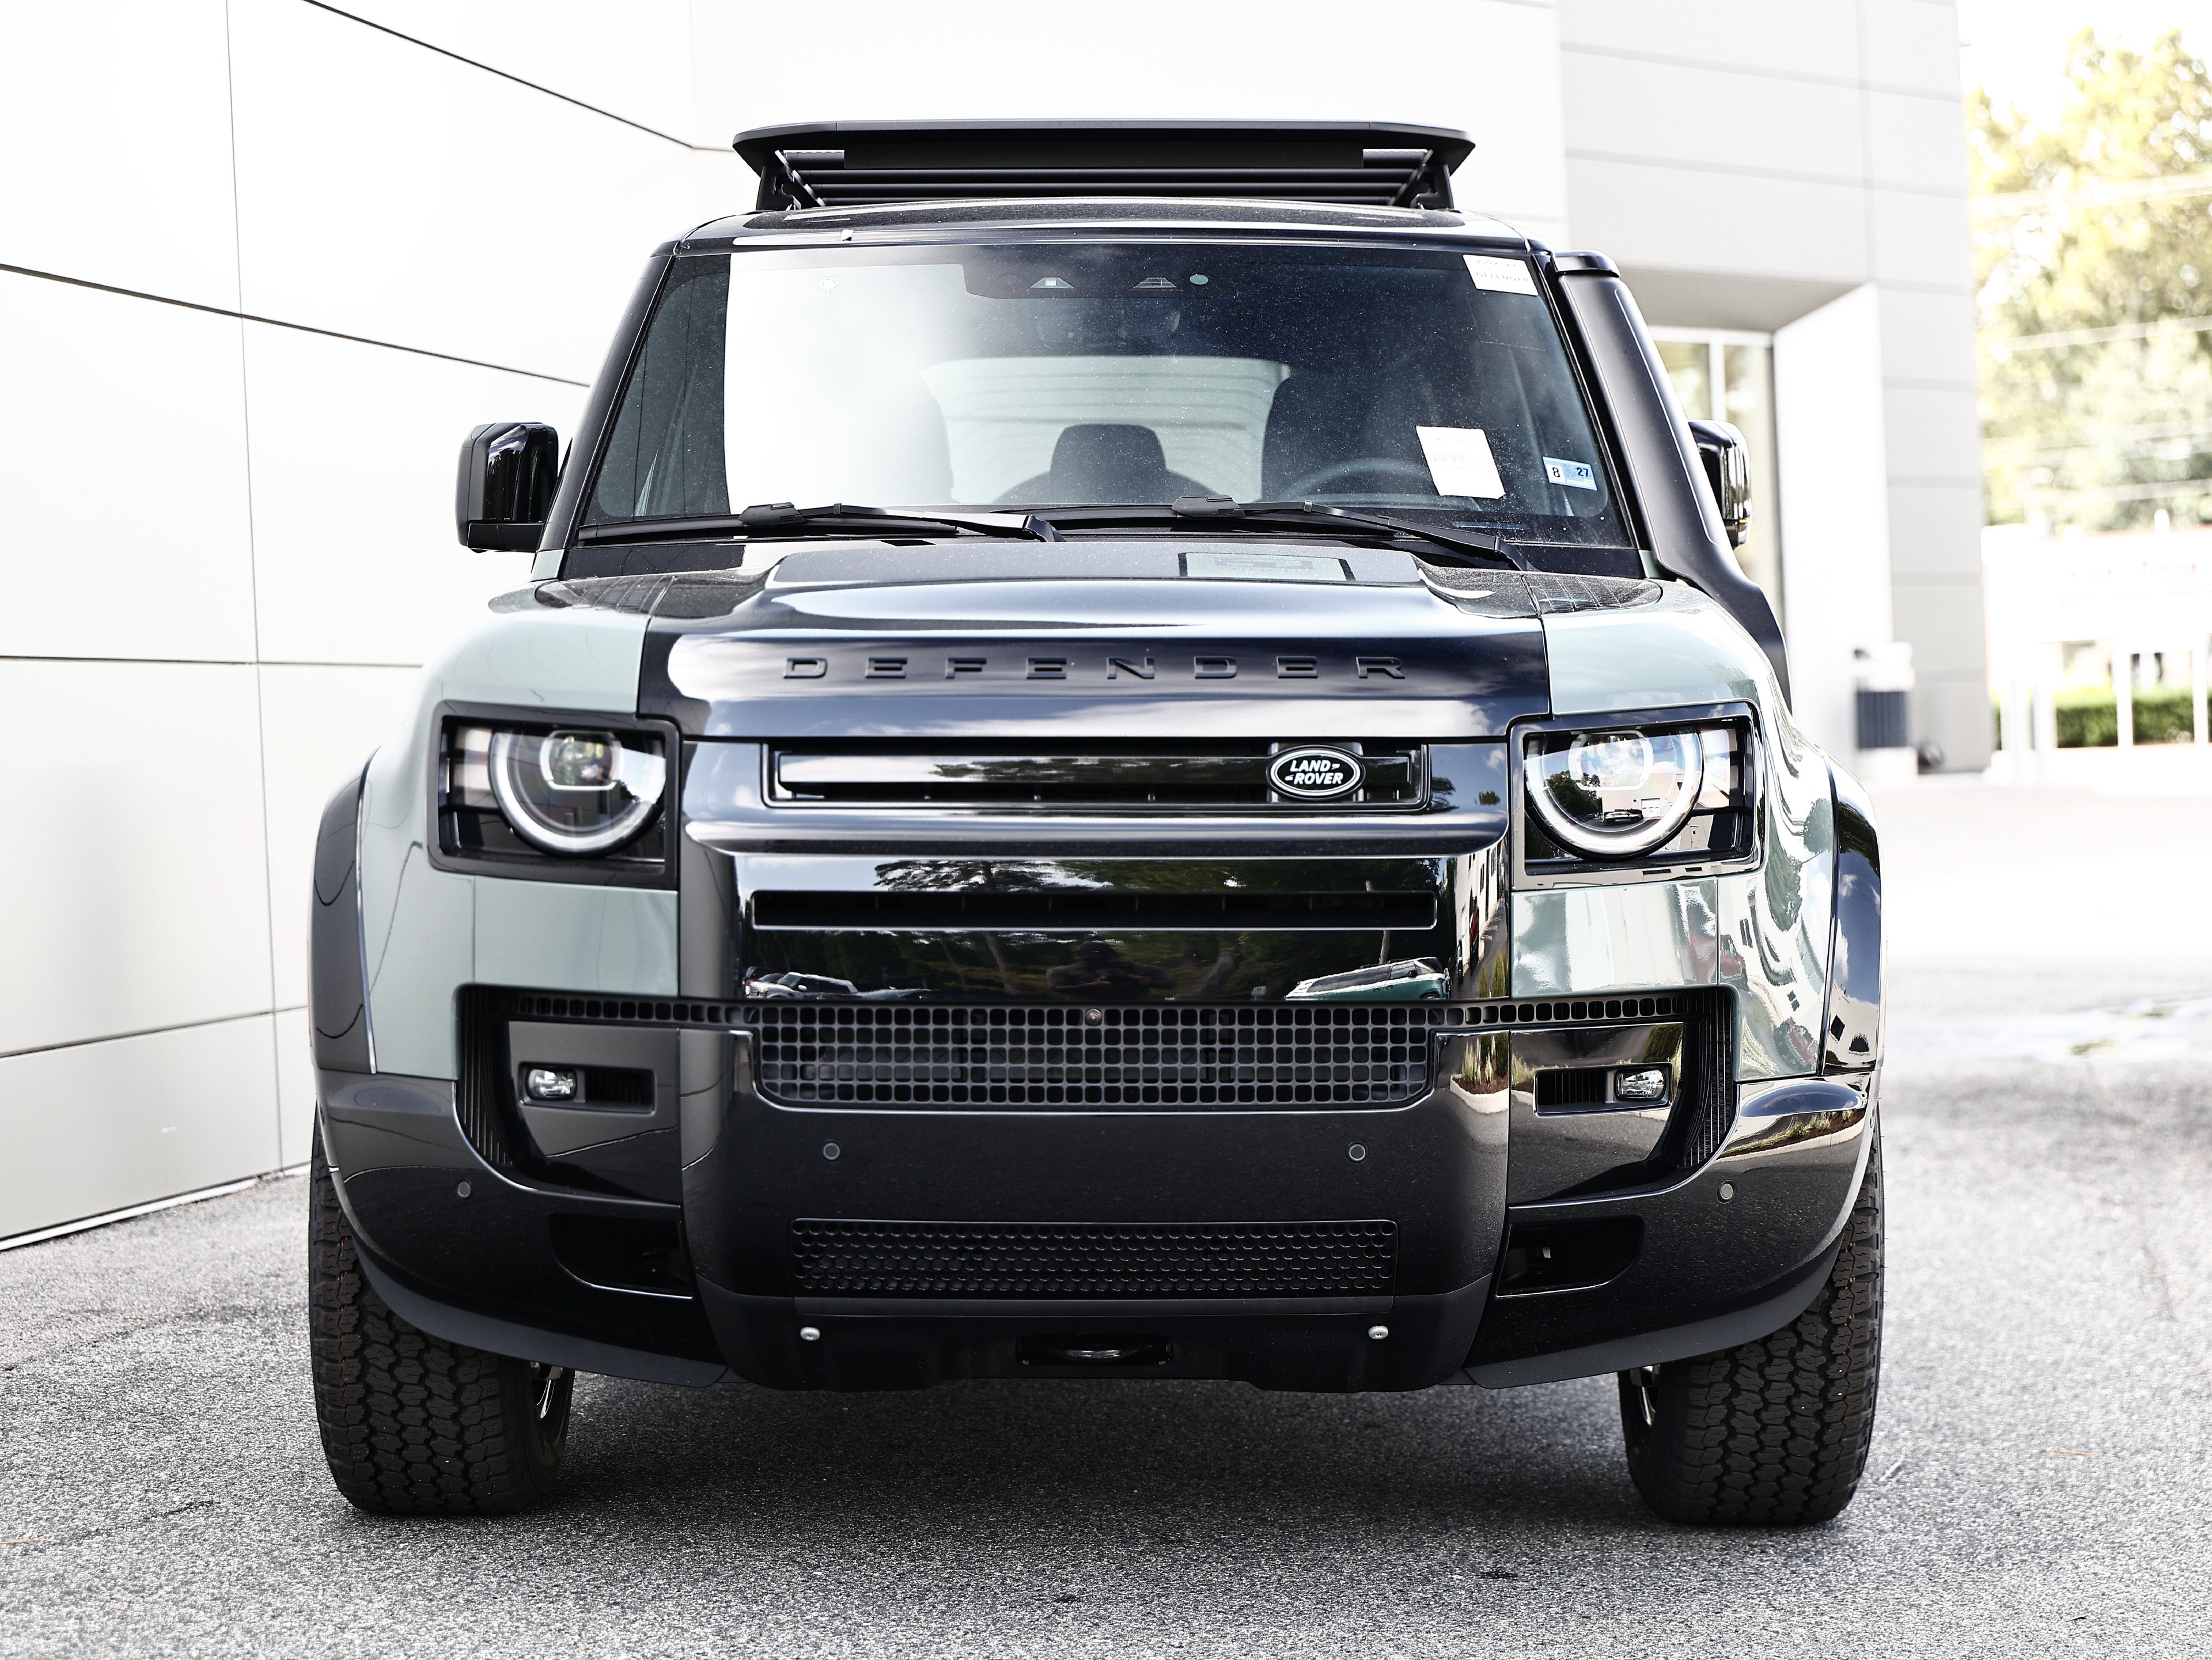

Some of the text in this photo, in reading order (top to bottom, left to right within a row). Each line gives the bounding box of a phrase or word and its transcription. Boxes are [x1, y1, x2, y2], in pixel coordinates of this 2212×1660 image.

[1552, 467, 1589, 477] 8 27
[782, 655, 1406, 680] DEFENDER
[1290, 759, 1331, 772] LAND
